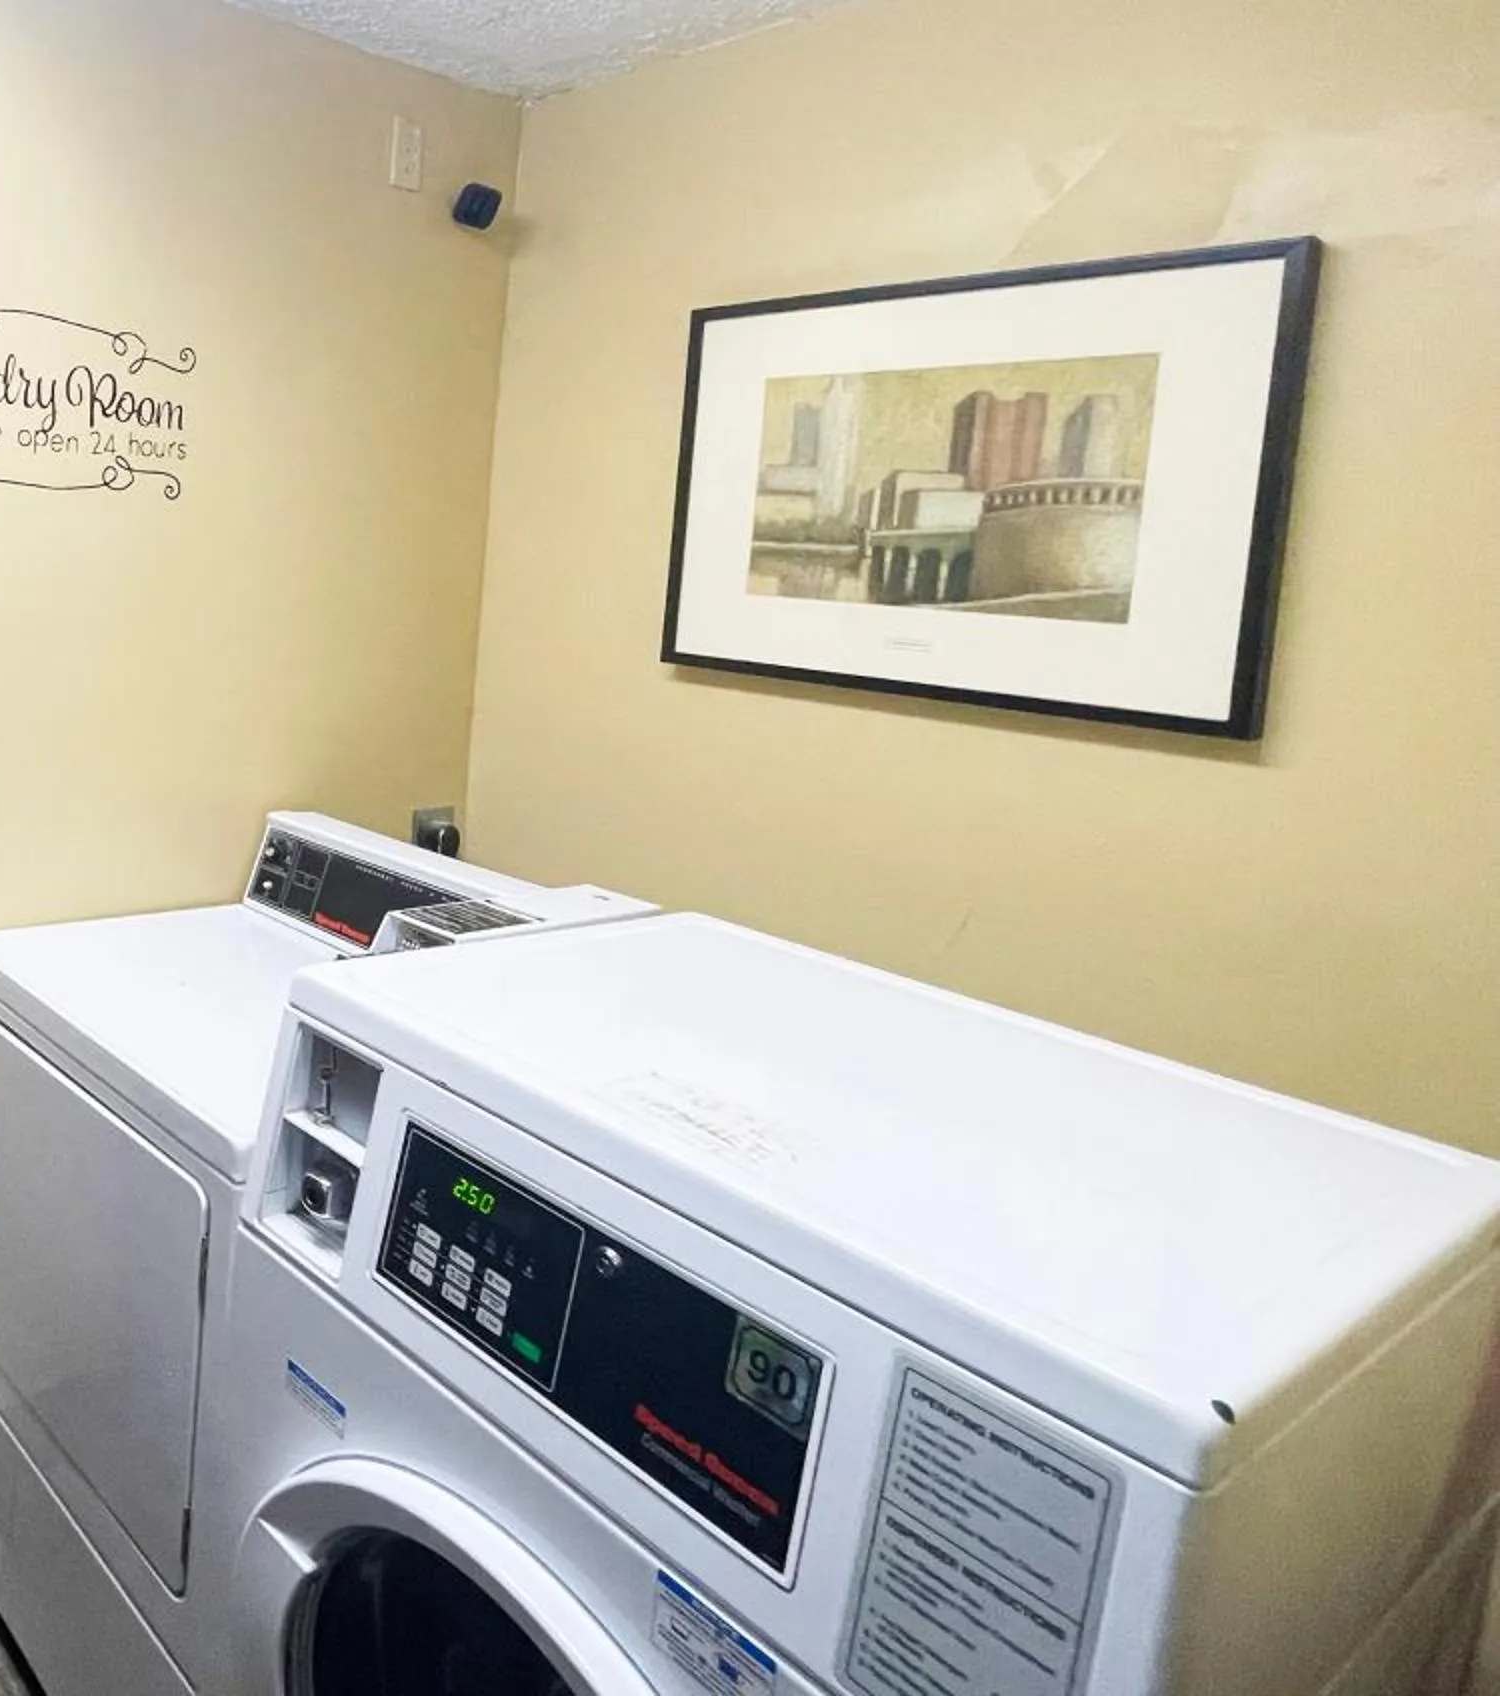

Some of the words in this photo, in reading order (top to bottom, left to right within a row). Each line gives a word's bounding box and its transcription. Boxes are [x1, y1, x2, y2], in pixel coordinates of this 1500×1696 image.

[66, 365, 184, 430] Room
[17, 428, 79, 453] open
[90, 431, 117, 454] 24
[129, 431, 187, 460] hours
[747, 1350, 796, 1400] 90
